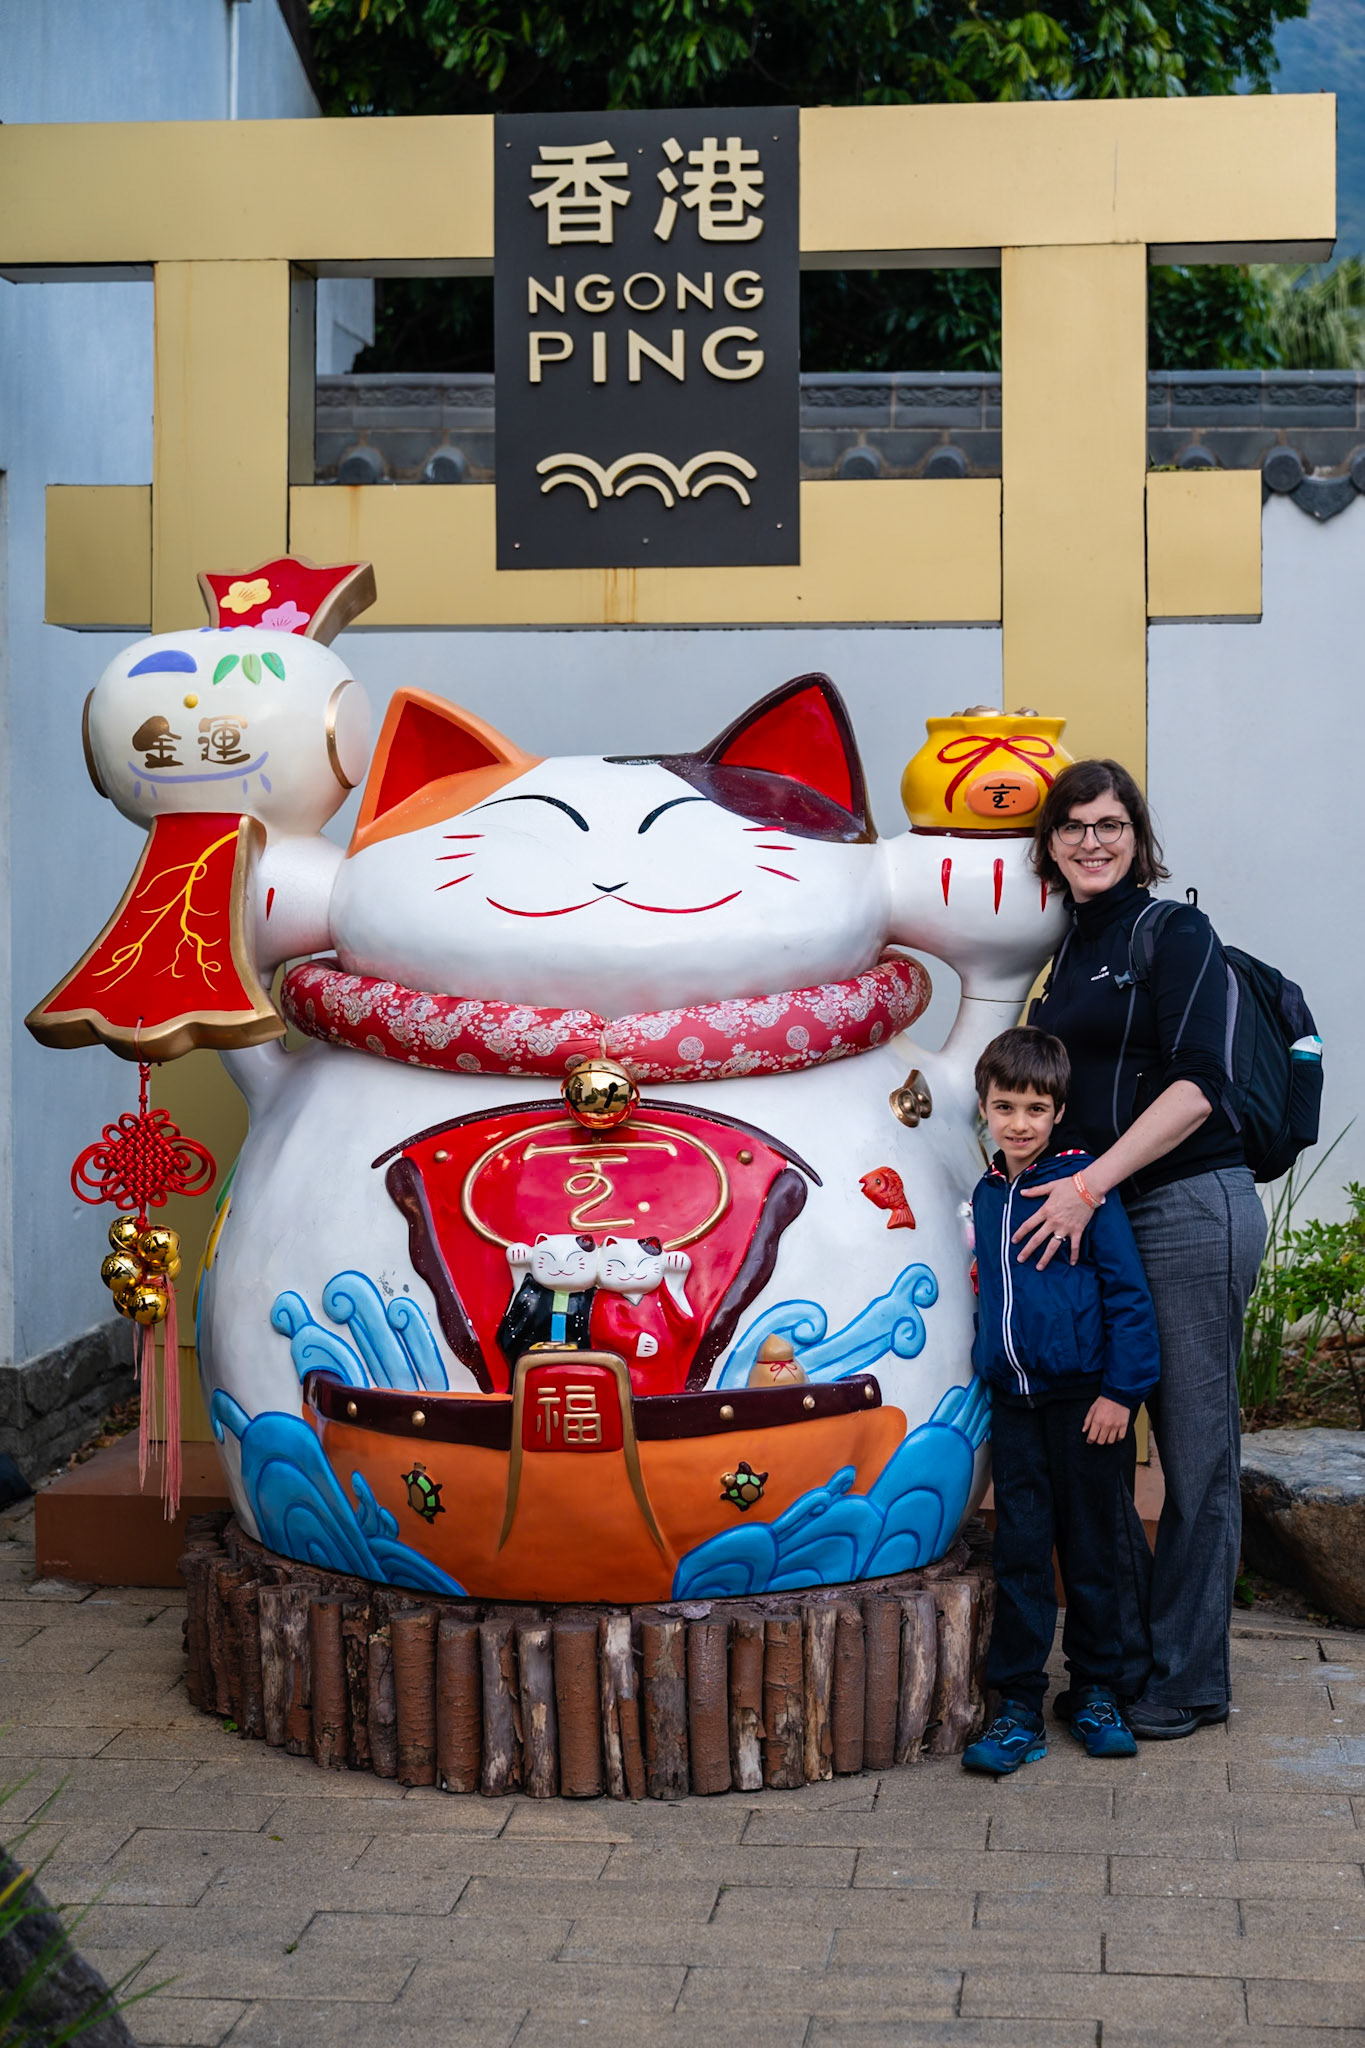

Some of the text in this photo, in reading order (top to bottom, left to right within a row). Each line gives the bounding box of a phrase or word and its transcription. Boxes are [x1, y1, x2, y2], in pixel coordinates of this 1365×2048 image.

[528, 136, 765, 245] 香港
[528, 269, 764, 314] NGONG
[529, 326, 765, 383] PING
[131, 714, 252, 769] 金運
[536, 1384, 603, 1445] 福
